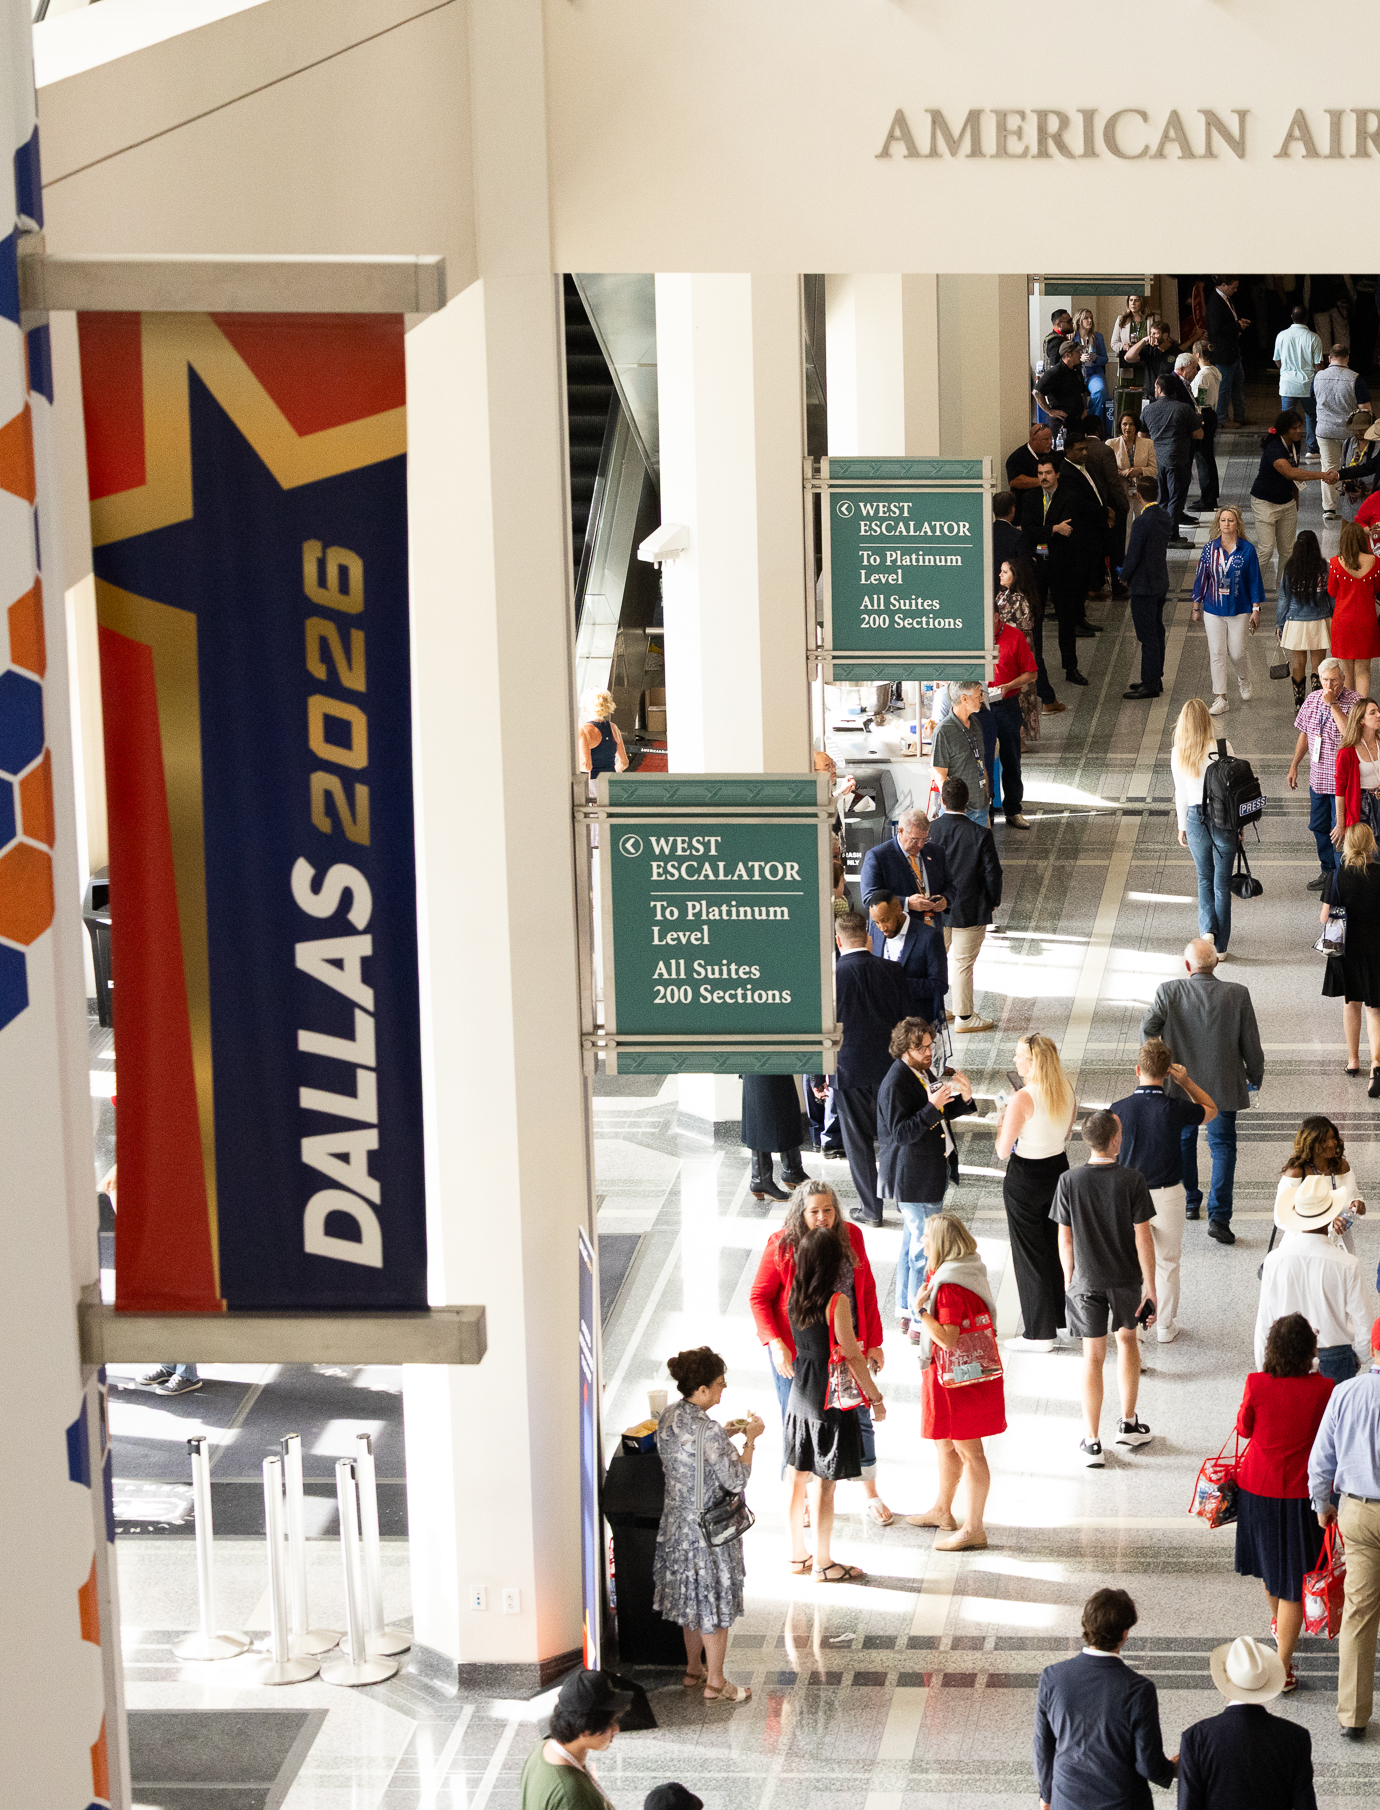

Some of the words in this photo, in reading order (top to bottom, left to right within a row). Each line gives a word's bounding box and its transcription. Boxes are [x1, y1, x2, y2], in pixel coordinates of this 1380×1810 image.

[876, 109, 1249, 158] AMERICAN
[859, 503, 913, 516] WEST
[859, 521, 971, 537] ESCALATOR
[859, 551, 881, 565] To
[885, 551, 962, 566] Platinum
[860, 569, 904, 584] Level
[860, 595, 886, 610] All
[890, 595, 940, 610] Suites
[860, 615, 890, 629] 200
[895, 614, 963, 629] Sections
[301, 537, 371, 847] 2026
[1241, 797, 1266, 815] PRESS
[649, 837, 721, 856] WEST
[651, 862, 802, 881] ESCALATOR
[651, 902, 679, 920] To
[685, 900, 790, 921] Platinum
[652, 925, 710, 945] Level
[652, 959, 687, 979] All
[693, 959, 761, 979] Suites
[653, 985, 692, 1004] 200
[700, 984, 792, 1004] Sections
[290, 855, 384, 1269] DALLAS
